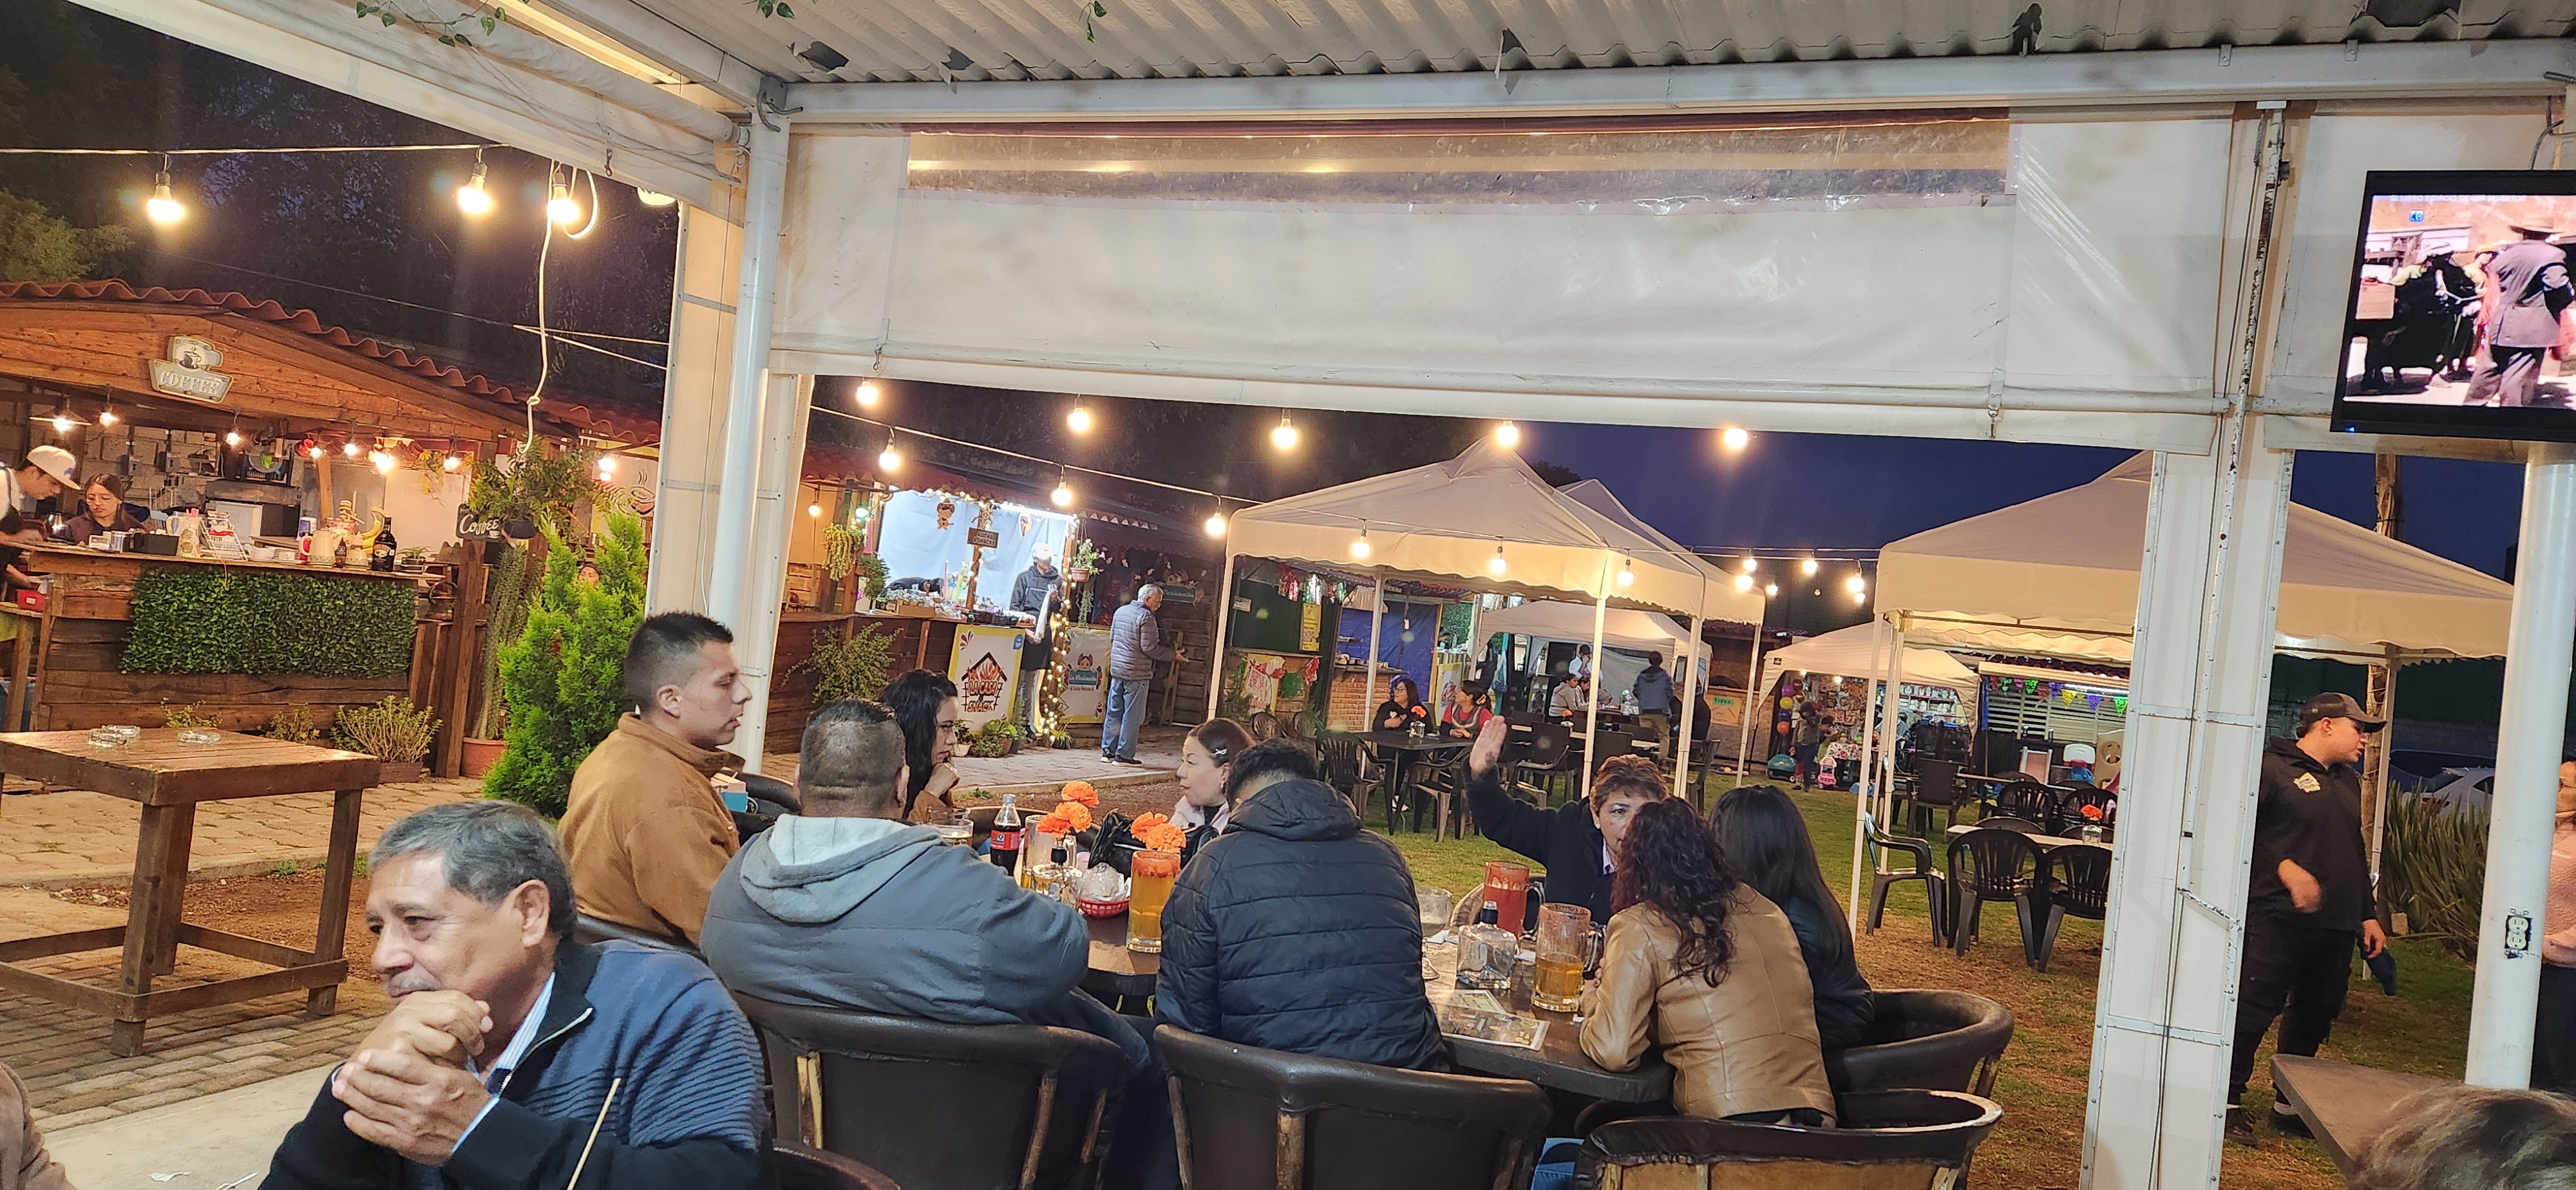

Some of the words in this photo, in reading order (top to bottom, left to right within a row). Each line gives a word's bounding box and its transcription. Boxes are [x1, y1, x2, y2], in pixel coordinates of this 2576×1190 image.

[159, 371, 220, 396] COFFEE
[977, 537, 996, 546] SNACKS
[969, 681, 978, 696] LA
[979, 681, 998, 696] CASA
[967, 701, 993, 713] SNACK
